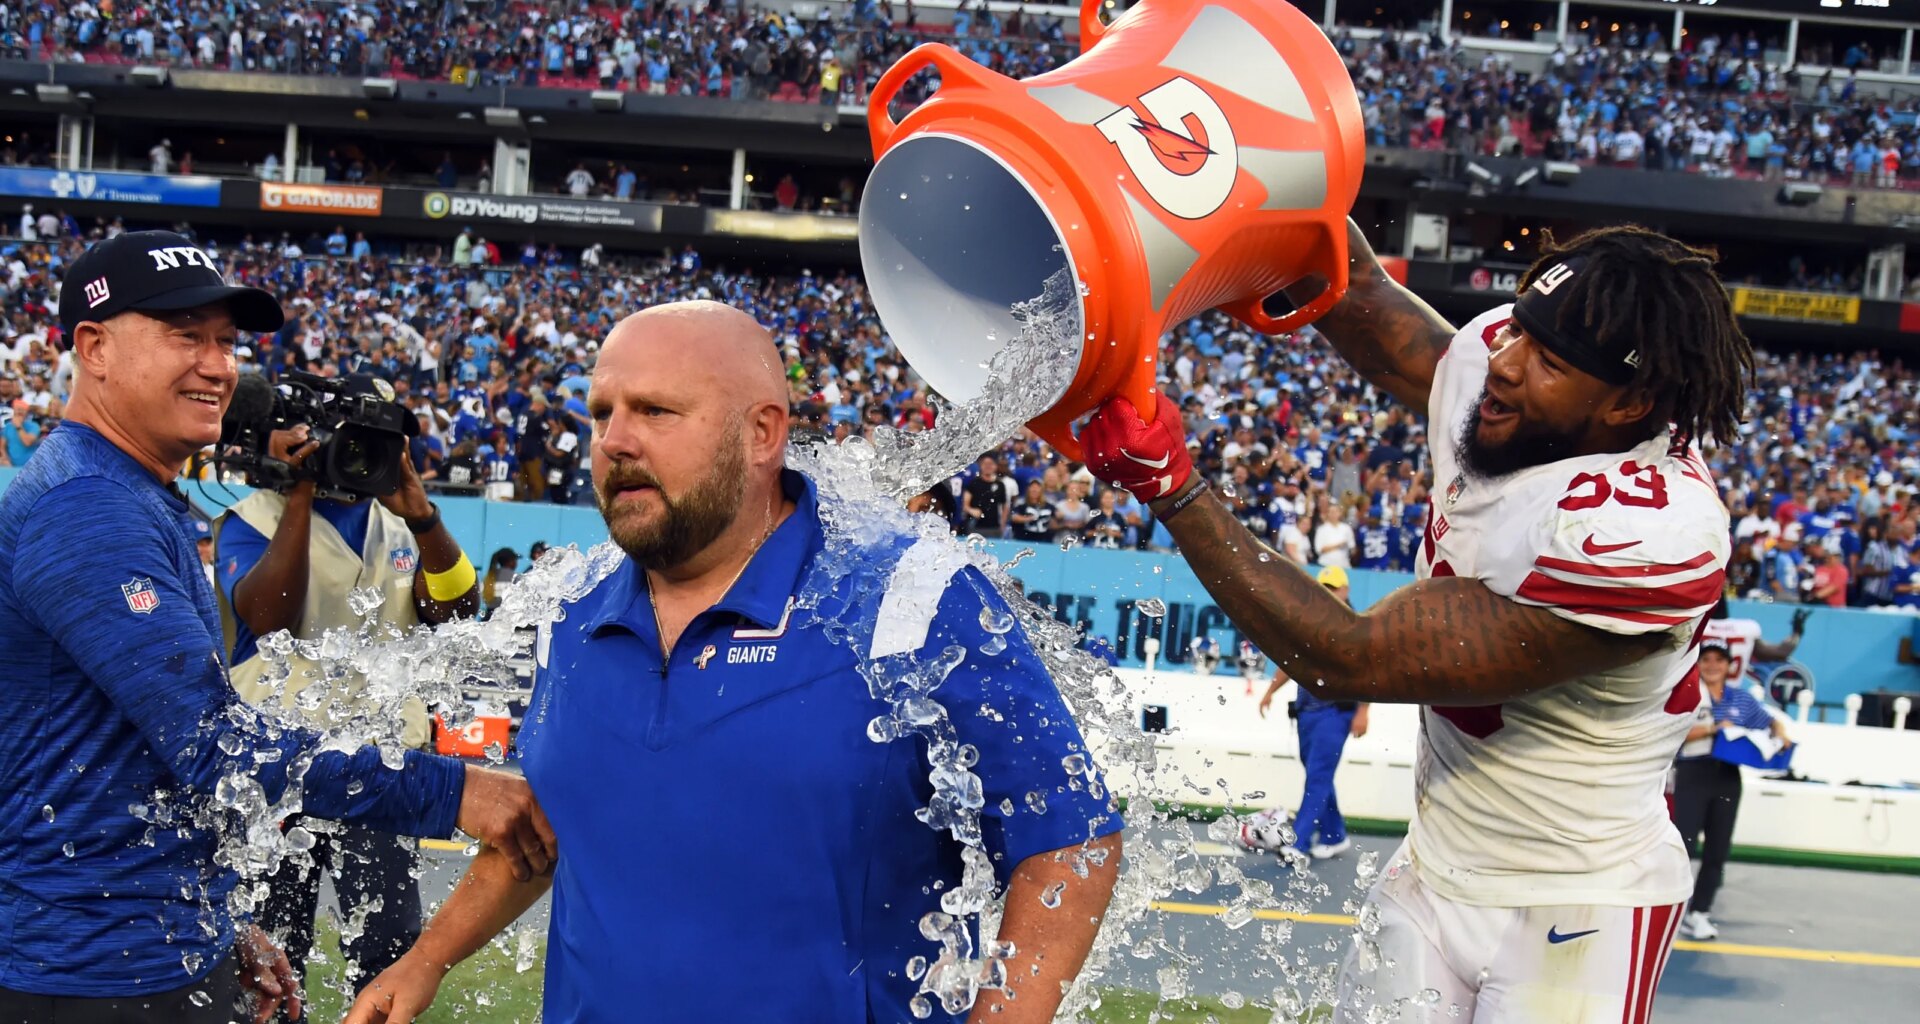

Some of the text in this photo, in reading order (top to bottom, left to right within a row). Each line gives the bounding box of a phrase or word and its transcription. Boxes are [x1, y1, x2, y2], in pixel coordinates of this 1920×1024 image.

[1094, 75, 1239, 221] G
[109, 190, 162, 204] Tennessee
[265, 186, 378, 210] G GATORADE
[451, 197, 538, 224] RJYoung
[542, 203, 620, 217] Technology Solutions
[602, 217, 635, 226] Business
[1492, 271, 1517, 292] LG
[490, 460, 509, 481] 10
[131, 591, 157, 609] NFL
[727, 646, 777, 663] GIANTS
[463, 721, 485, 744] G
